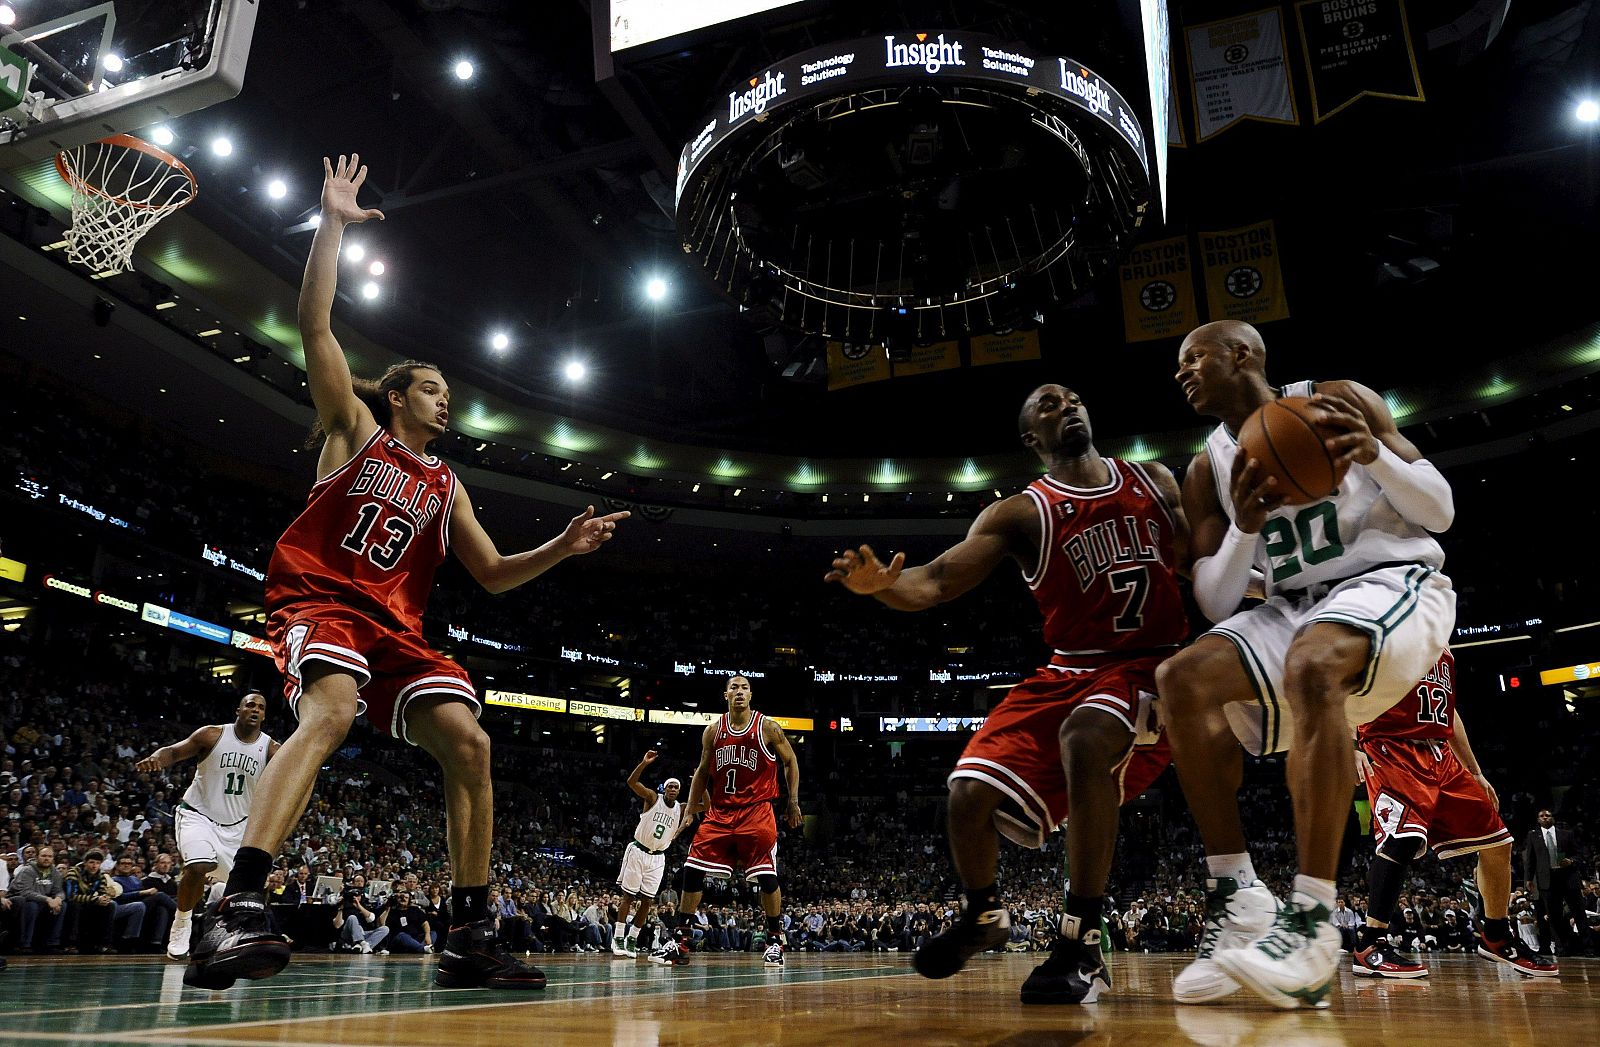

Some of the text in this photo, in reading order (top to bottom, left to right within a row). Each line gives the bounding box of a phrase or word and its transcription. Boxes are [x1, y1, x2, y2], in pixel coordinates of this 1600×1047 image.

[1323, 3, 1377, 24] BRUINS
[982, 46, 1034, 68] Technology
[1336, 43, 1379, 59] TROPHY
[801, 53, 854, 74] Technology
[983, 58, 1029, 76] Solutions
[1231, 66, 1255, 77] WALES
[802, 65, 846, 86] Solutions
[1203, 227, 1272, 251] BOSTON
[1206, 243, 1274, 267] BRUINS
[1122, 256, 1187, 281] BRUINS
[346, 457, 441, 535] BULLS
[340, 501, 415, 571] 13
[1260, 501, 1345, 583] 20
[46, 577, 92, 599] comcast
[1107, 565, 1150, 632] 7
[97, 593, 139, 613] comcast
[674, 661, 696, 676] Insight
[930, 669, 951, 684] Insight
[503, 693, 561, 711] NFS Leasing
[570, 702, 609, 714] SPORTS
[1416, 685, 1450, 728] 12
[220, 751, 259, 777] CELTICS
[716, 744, 758, 772] BULLS
[224, 772, 246, 796] 11
[725, 768, 737, 795] 1
[653, 824, 666, 840] 9
